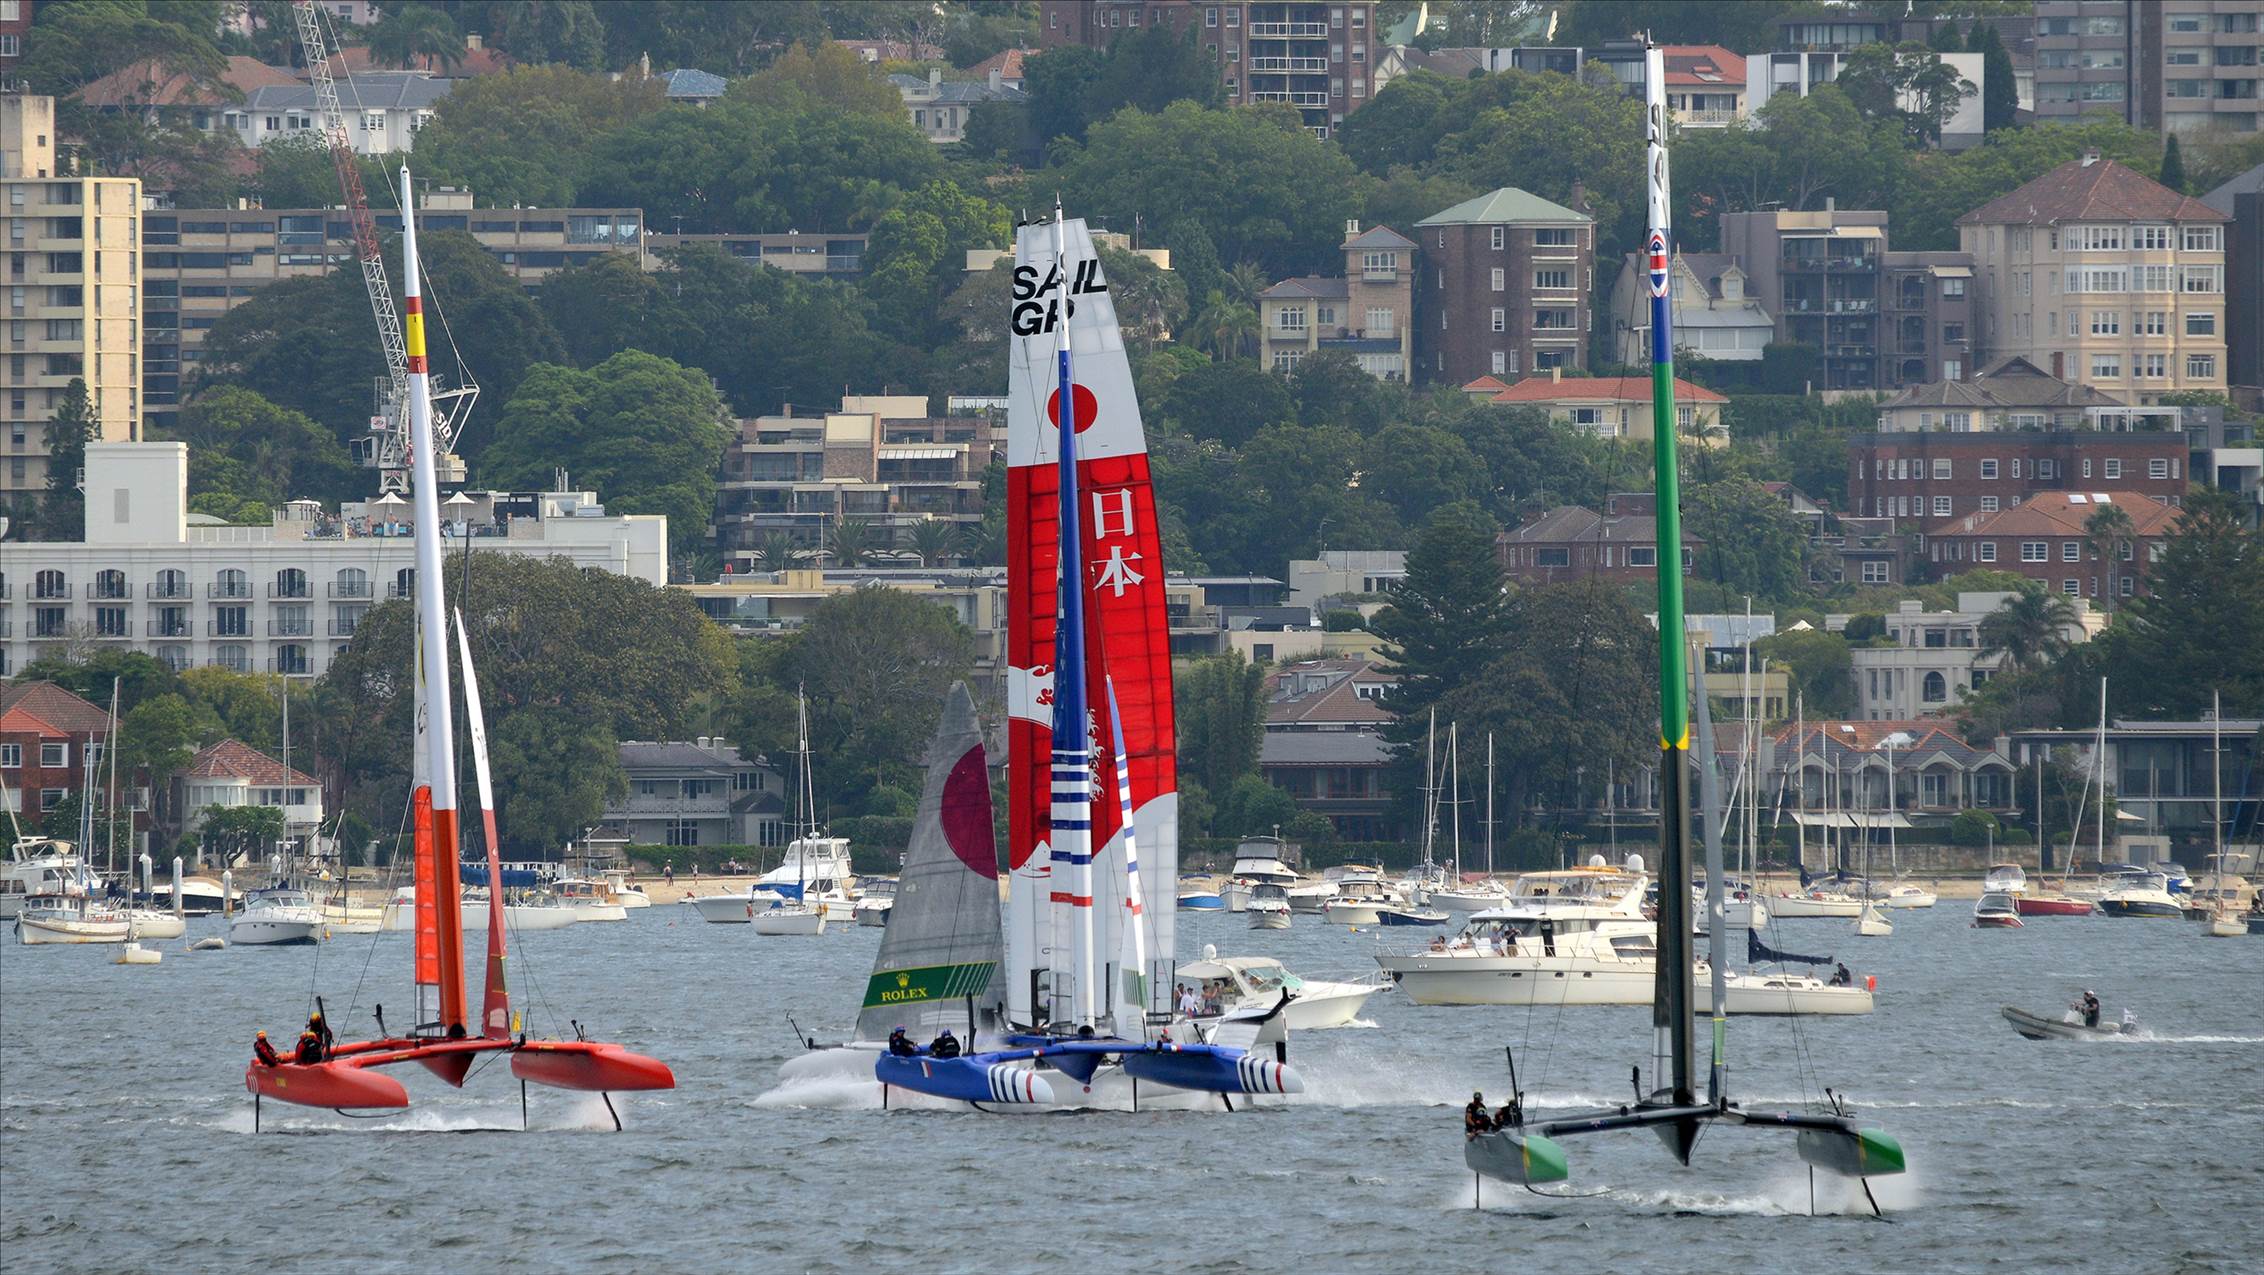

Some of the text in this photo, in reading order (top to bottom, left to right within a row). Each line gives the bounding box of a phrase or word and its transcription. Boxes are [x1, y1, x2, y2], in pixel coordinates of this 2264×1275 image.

[1013, 259, 1107, 301] SAIL
[1011, 298, 1075, 337] GP
[1091, 488, 1145, 597] 日本
[881, 987, 928, 1001] ROLEX
